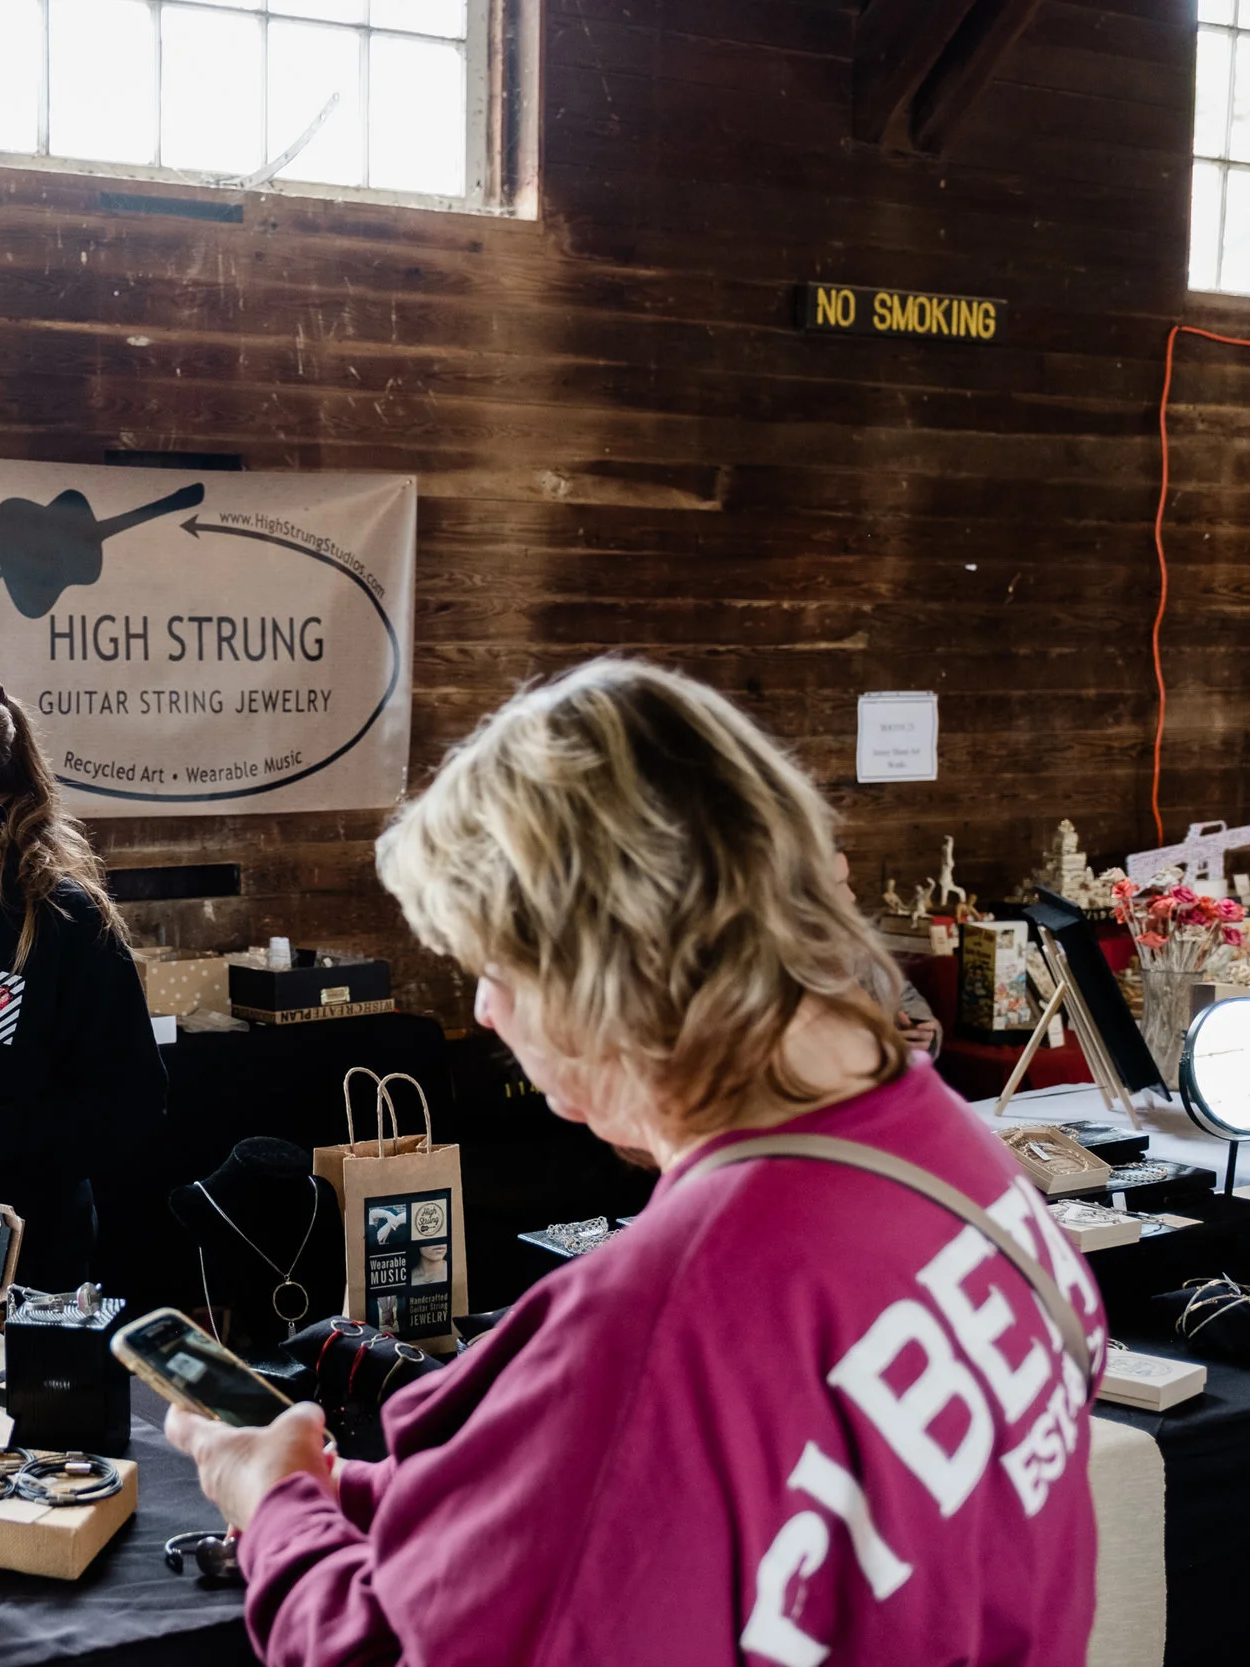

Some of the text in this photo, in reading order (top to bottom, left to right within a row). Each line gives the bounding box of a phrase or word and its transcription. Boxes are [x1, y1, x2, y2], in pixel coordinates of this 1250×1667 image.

[817, 287, 997, 339] NO SMOKING
[219, 512, 386, 599] www.HighStrungStudios.com
[49, 614, 324, 662] HIGH STRUNG
[39, 689, 332, 715] GUITAR STRING JEWELRY
[64, 749, 303, 784] Recycled Art Wearable Music
[370, 1256, 407, 1271] Wearable
[370, 1267, 407, 1286] MUSIC
[409, 1310, 448, 1327] JEWELRY
